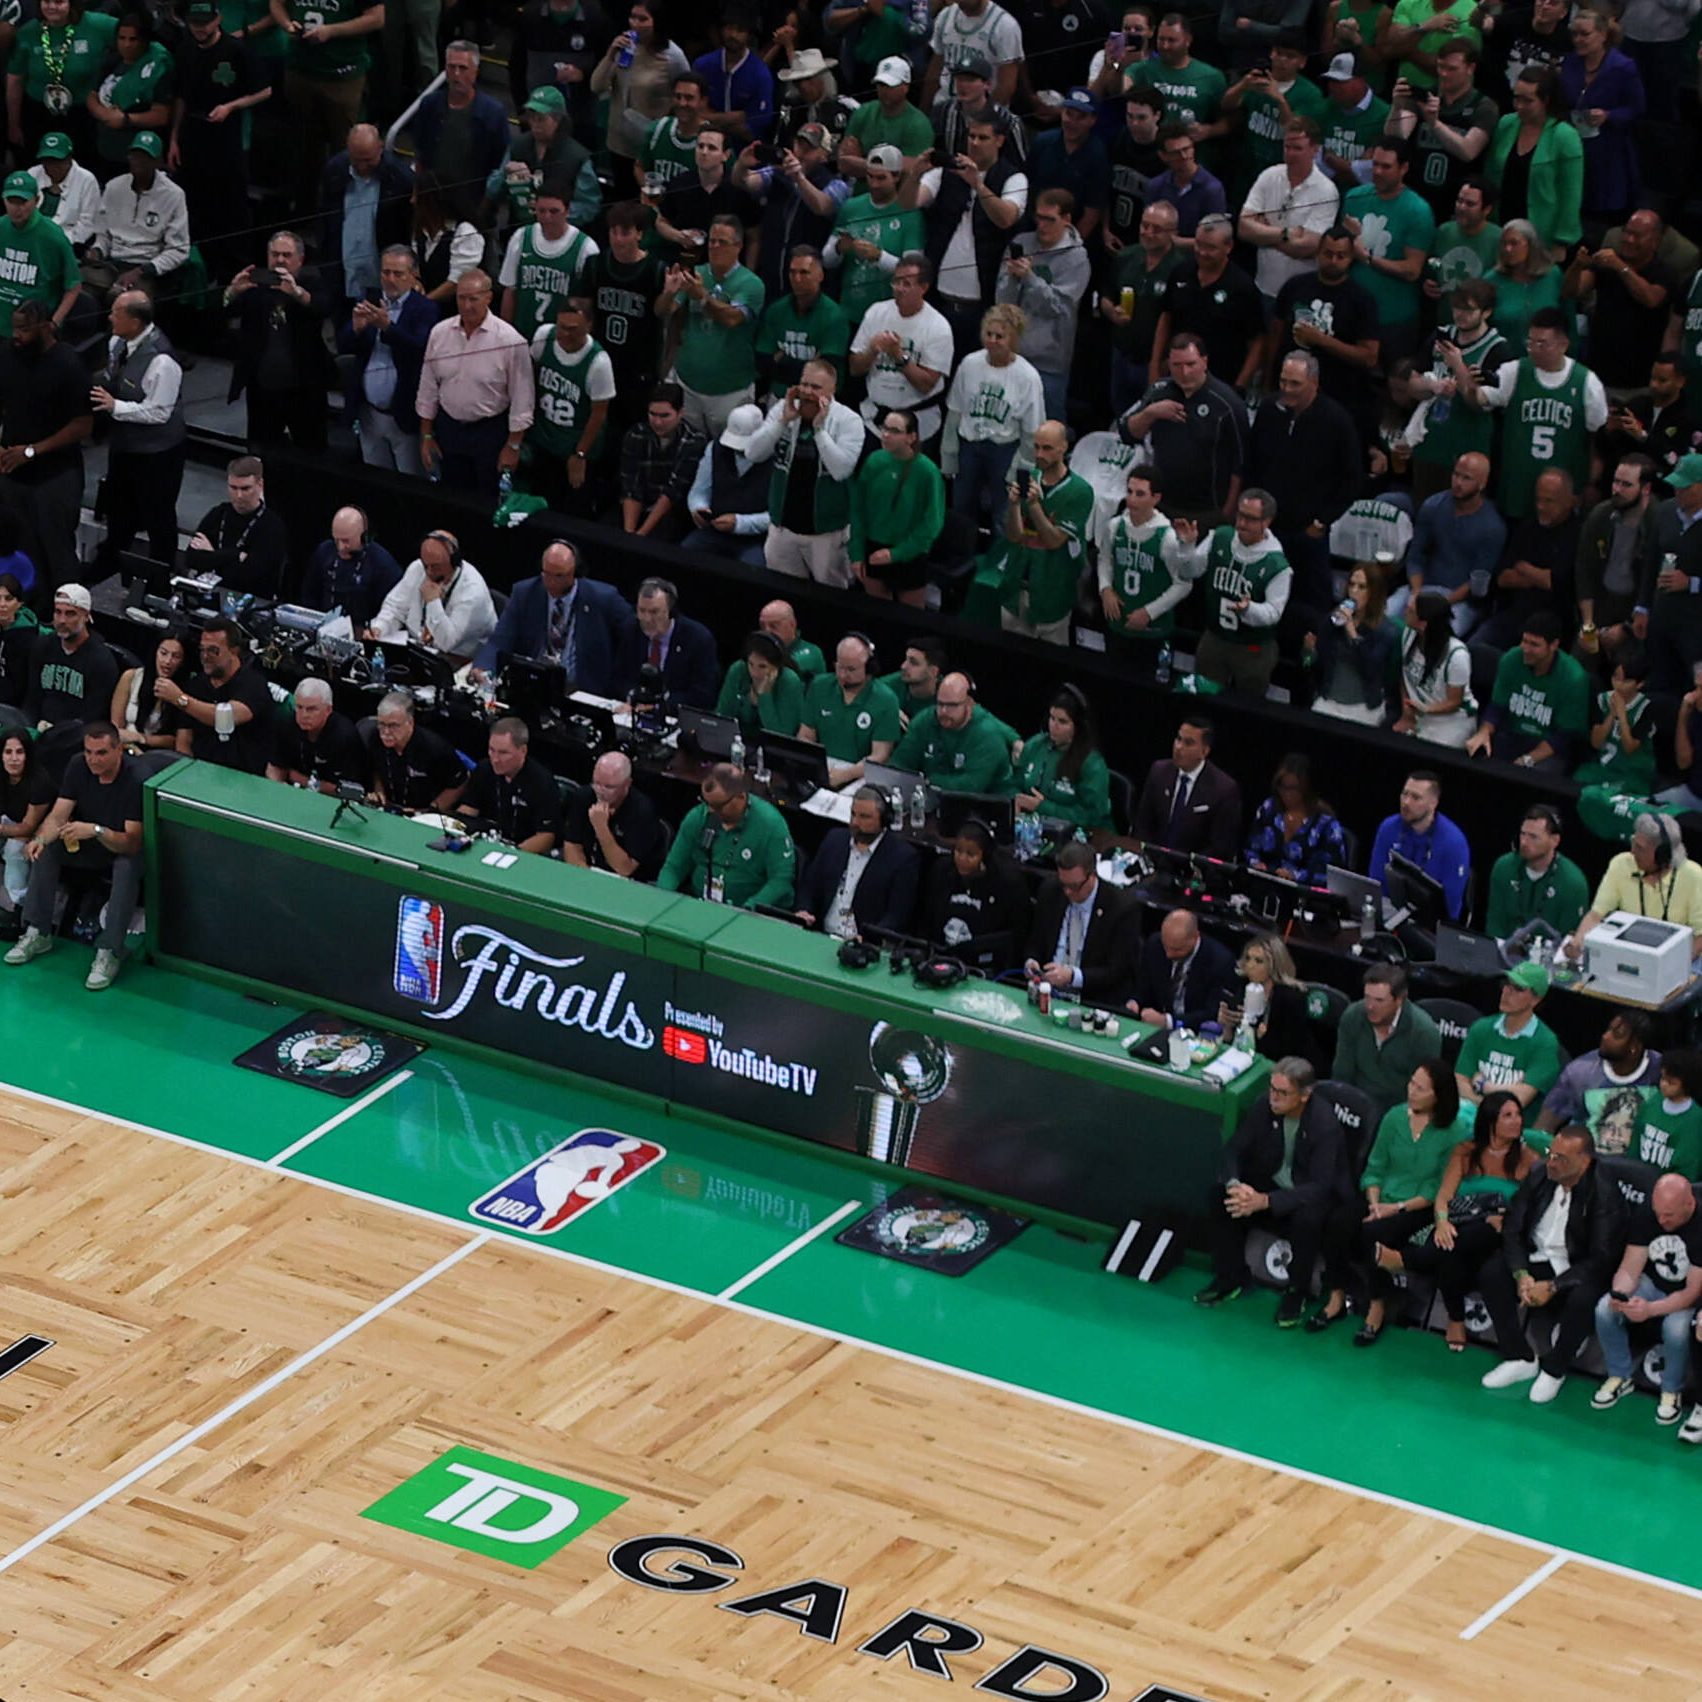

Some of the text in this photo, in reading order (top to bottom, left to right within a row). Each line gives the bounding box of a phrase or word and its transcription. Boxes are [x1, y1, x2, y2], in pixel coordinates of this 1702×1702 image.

[1425, 152, 1448, 185] 0
[521, 264, 571, 297] BOSTON
[535, 290, 552, 322] 7
[606, 314, 628, 345] 0
[539, 394, 575, 427] 42
[1521, 398, 1572, 429] CELTICS
[1531, 426, 1555, 460] 5
[1124, 569, 1141, 596] 0
[1218, 597, 1239, 632] 5
[41, 664, 84, 700] BOSTON
[1509, 692, 1553, 727] BOSTON
[421, 925, 655, 1049] Finals
[484, 1196, 538, 1226] NBA
[423, 1462, 581, 1544] TD
